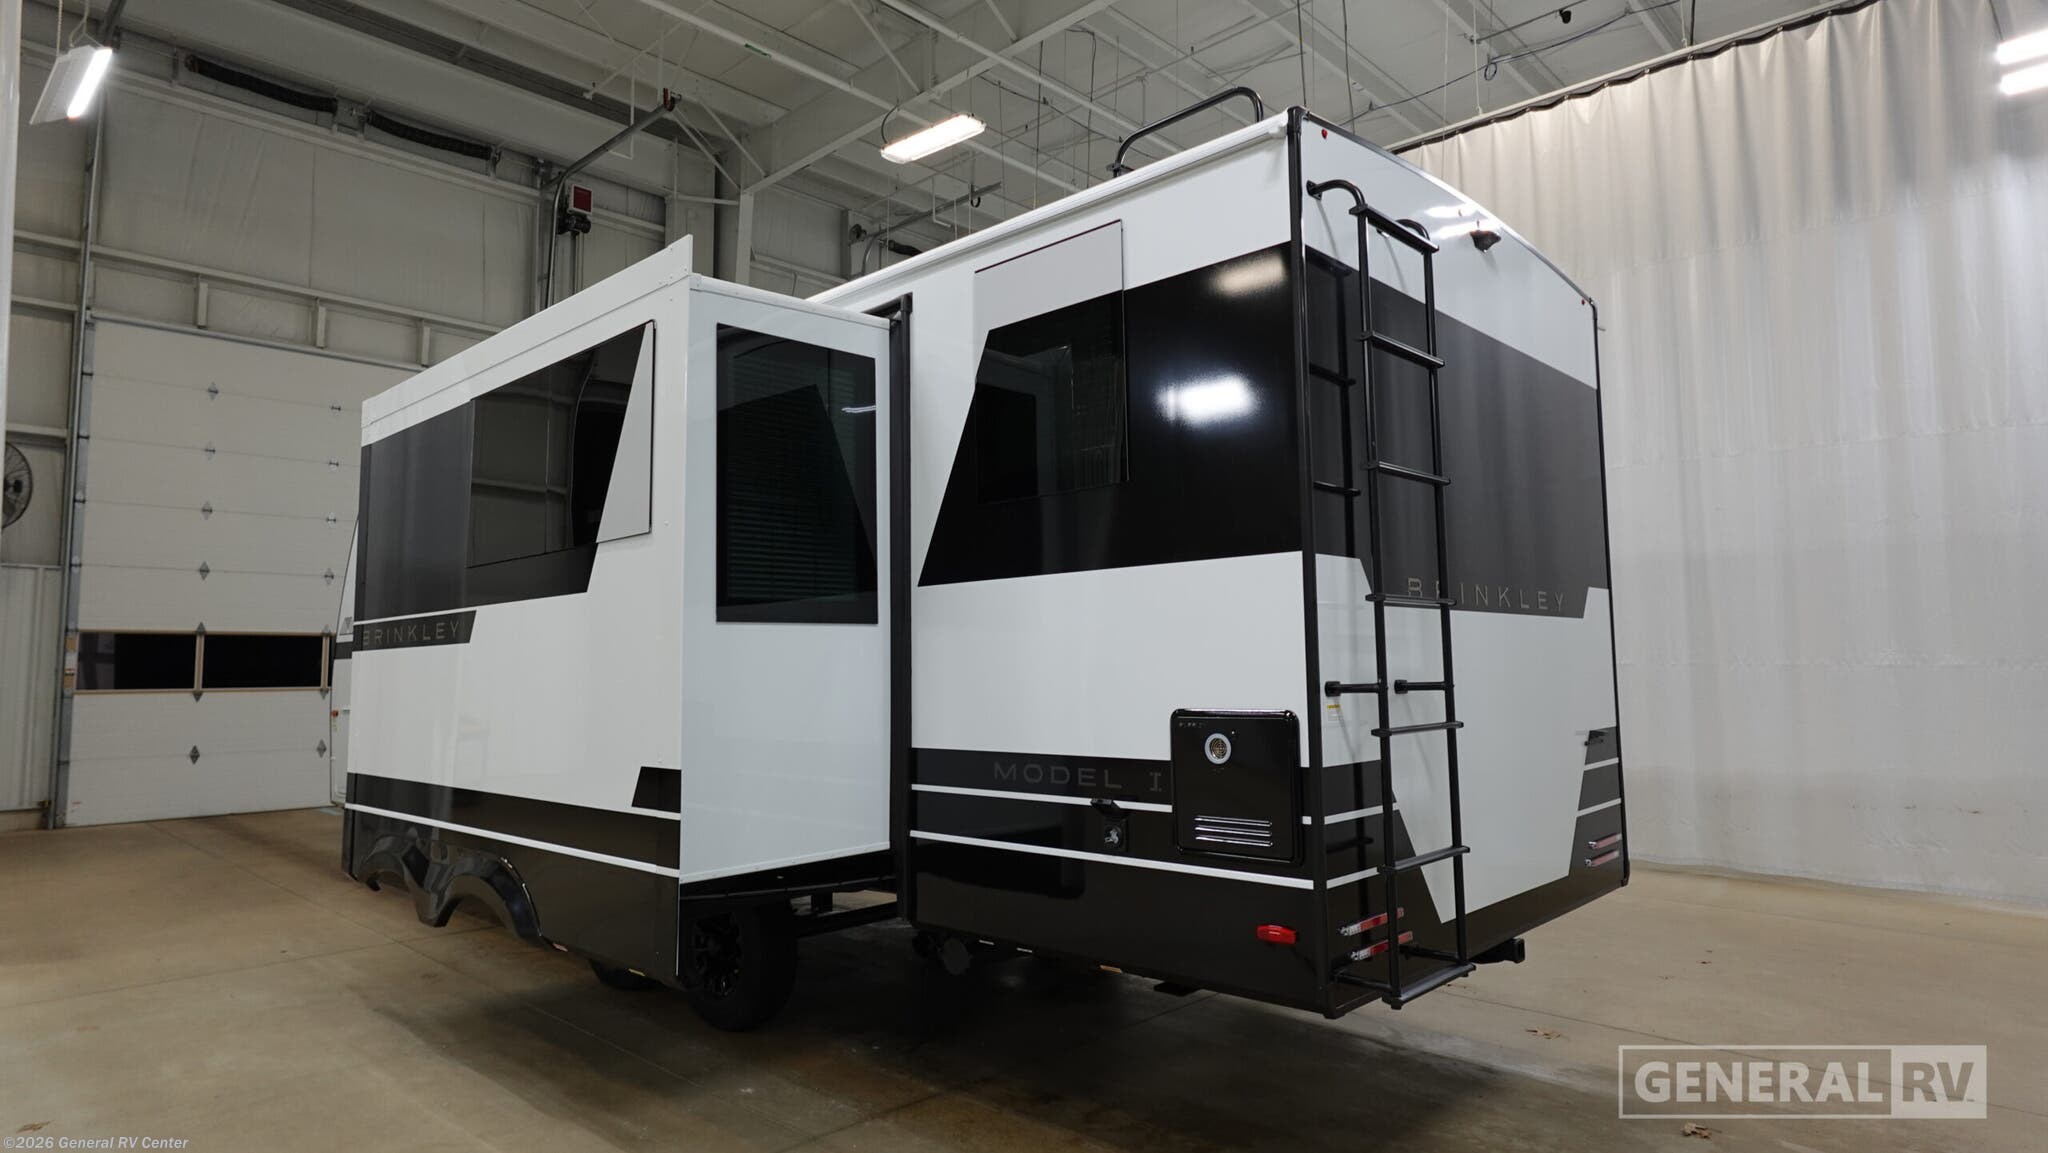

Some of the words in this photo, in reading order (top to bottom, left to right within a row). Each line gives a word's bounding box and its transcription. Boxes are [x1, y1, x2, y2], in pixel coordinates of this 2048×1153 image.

[1407, 576, 1567, 612] BINKLEY
[993, 761, 1123, 789] MODEL
[1149, 771, 1163, 793] I
